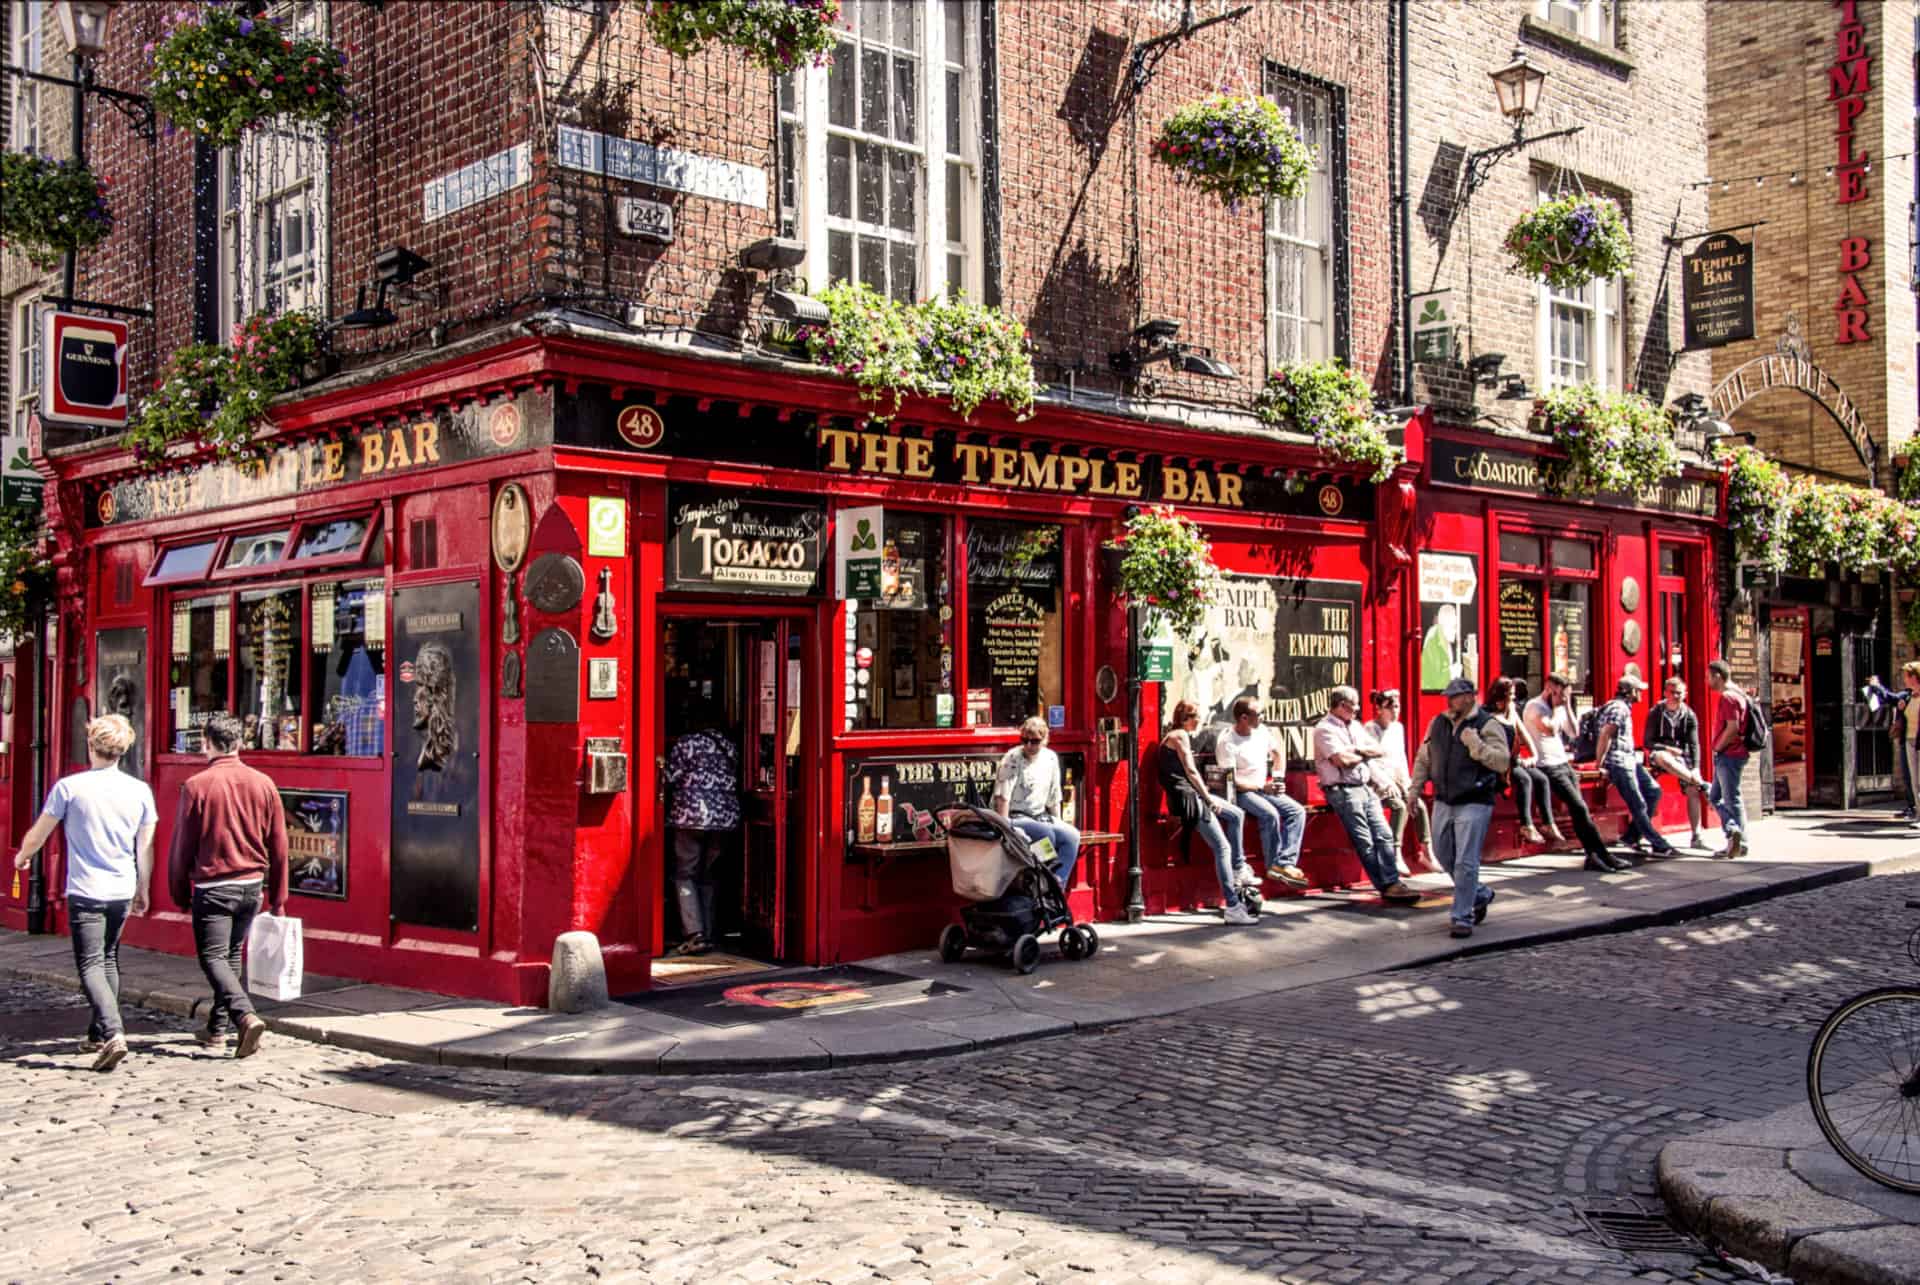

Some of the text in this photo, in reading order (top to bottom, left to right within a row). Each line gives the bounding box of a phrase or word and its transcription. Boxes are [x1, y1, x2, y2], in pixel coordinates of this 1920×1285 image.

[1827, 0, 1872, 344] TEMPLE BAR
[1690, 254, 1746, 273] TEMPLE
[1703, 270, 1733, 286] BAR
[1759, 357, 1827, 399] TEMPLE
[626, 410, 654, 438] 48
[362, 421, 440, 475] BAR
[821, 429, 1244, 508] THE TEMPLE BAR
[1322, 490, 1338, 509] 48
[691, 527, 805, 575] TOBACCO
[716, 567, 760, 582] Always
[765, 571, 776, 581] in
[1214, 587, 1269, 609] EMPLE
[1224, 608, 1258, 630] BAR
[1322, 607, 1349, 632] THE
[1288, 633, 1349, 659] EMPEROR
[1333, 662, 1349, 685] OF
[1263, 697, 1302, 722] ALTED
[896, 760, 1001, 785] THE TEMPL
[288, 835, 326, 853] HISKEY
